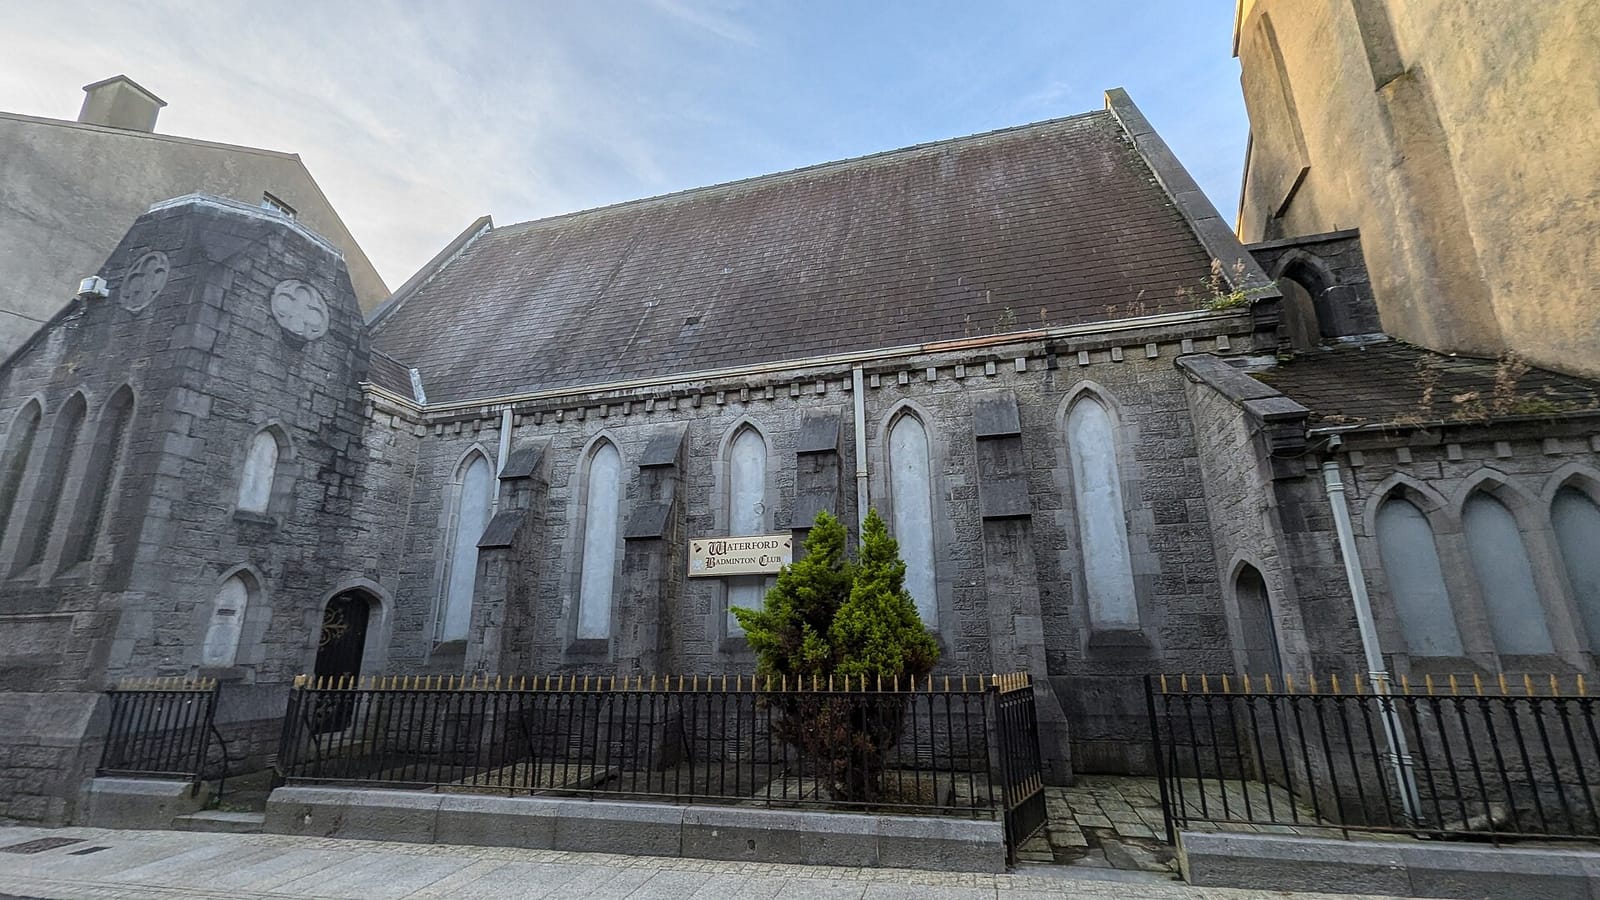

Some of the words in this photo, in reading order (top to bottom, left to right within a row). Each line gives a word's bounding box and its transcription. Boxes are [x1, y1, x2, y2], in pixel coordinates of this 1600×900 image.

[708, 541, 778, 555] WATERFORD
[705, 557, 756, 568] BADMINTON
[758, 555, 781, 566] CLUB
